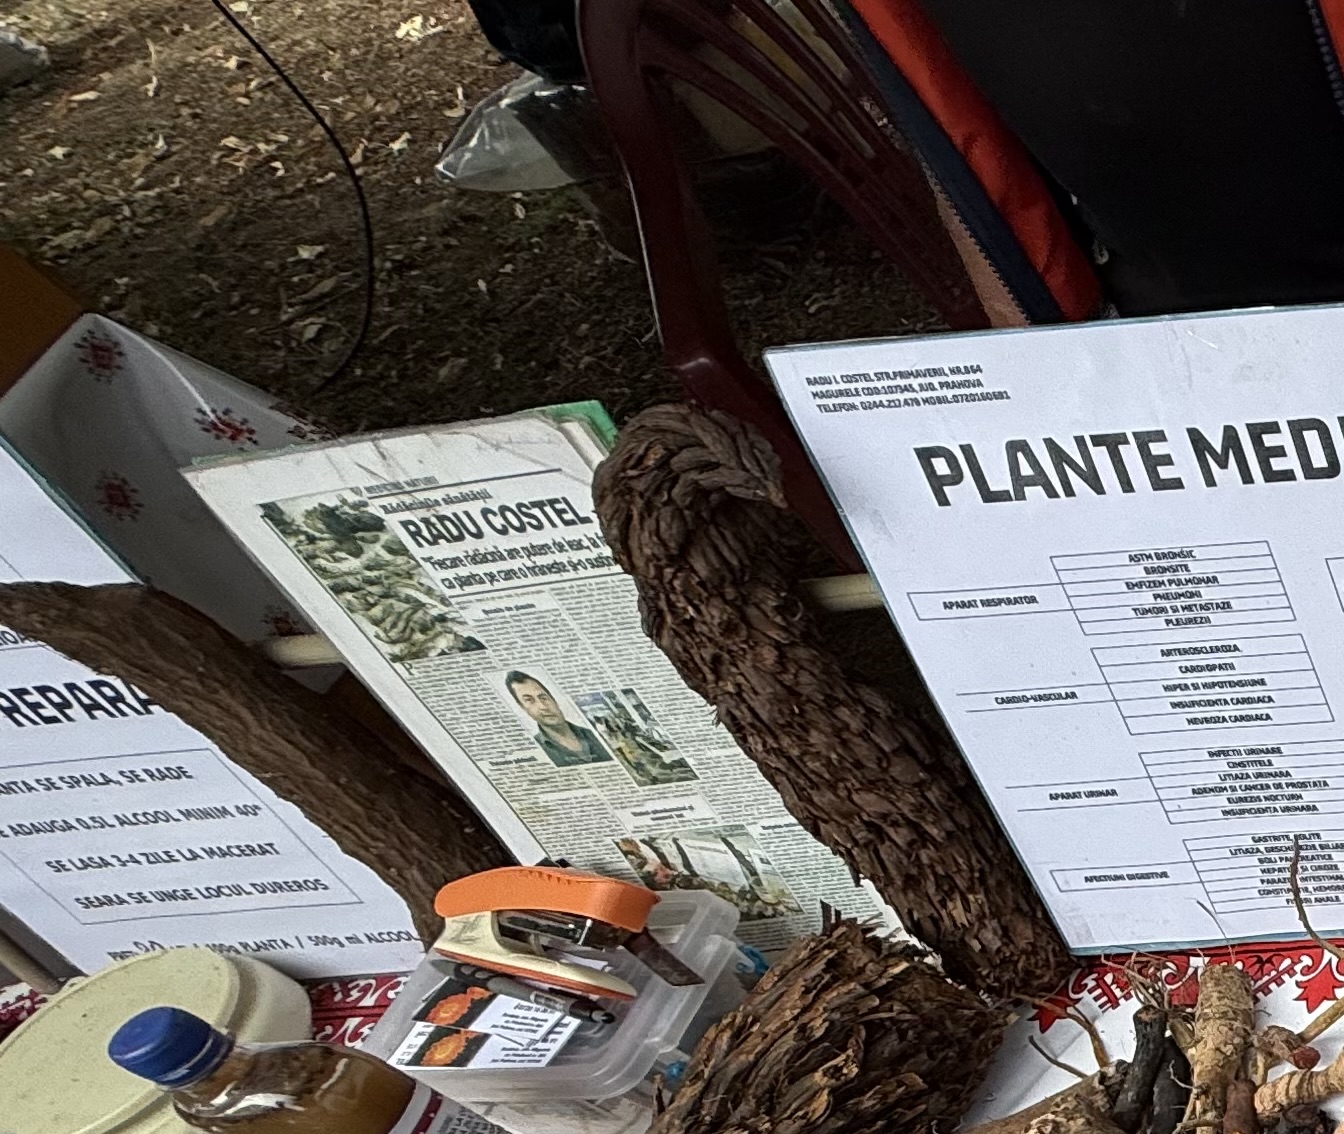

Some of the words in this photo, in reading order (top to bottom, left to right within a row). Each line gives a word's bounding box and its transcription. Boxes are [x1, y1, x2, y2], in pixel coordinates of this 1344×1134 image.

[912, 428, 1185, 507] PLANTE
[398, 510, 485, 548] RADU
[480, 496, 594, 536] COSTEL
[942, 598, 978, 610] APARAT
[36, 777, 59, 792] SE
[118, 770, 145, 783] SE
[142, 766, 194, 781] RADE
[9, 819, 79, 837] ADAUGA
[113, 810, 182, 827] ALCOOL
[177, 805, 233, 822] MINIM
[45, 859, 72, 873] SE
[68, 855, 115, 871] LASA
[111, 853, 143, 867] 3-4
[138, 850, 181, 865] ZILE
[177, 848, 204, 862] LA
[202, 842, 281, 859] MACERAT
[74, 891, 132, 909] SEARA
[127, 891, 158, 905] SE
[154, 888, 200, 903] UNGE
[196, 883, 253, 900] LOCUL
[250, 878, 330, 895] DUREROS
[238, 938, 294, 953] PLANTA
[307, 934, 345, 948] 500g
